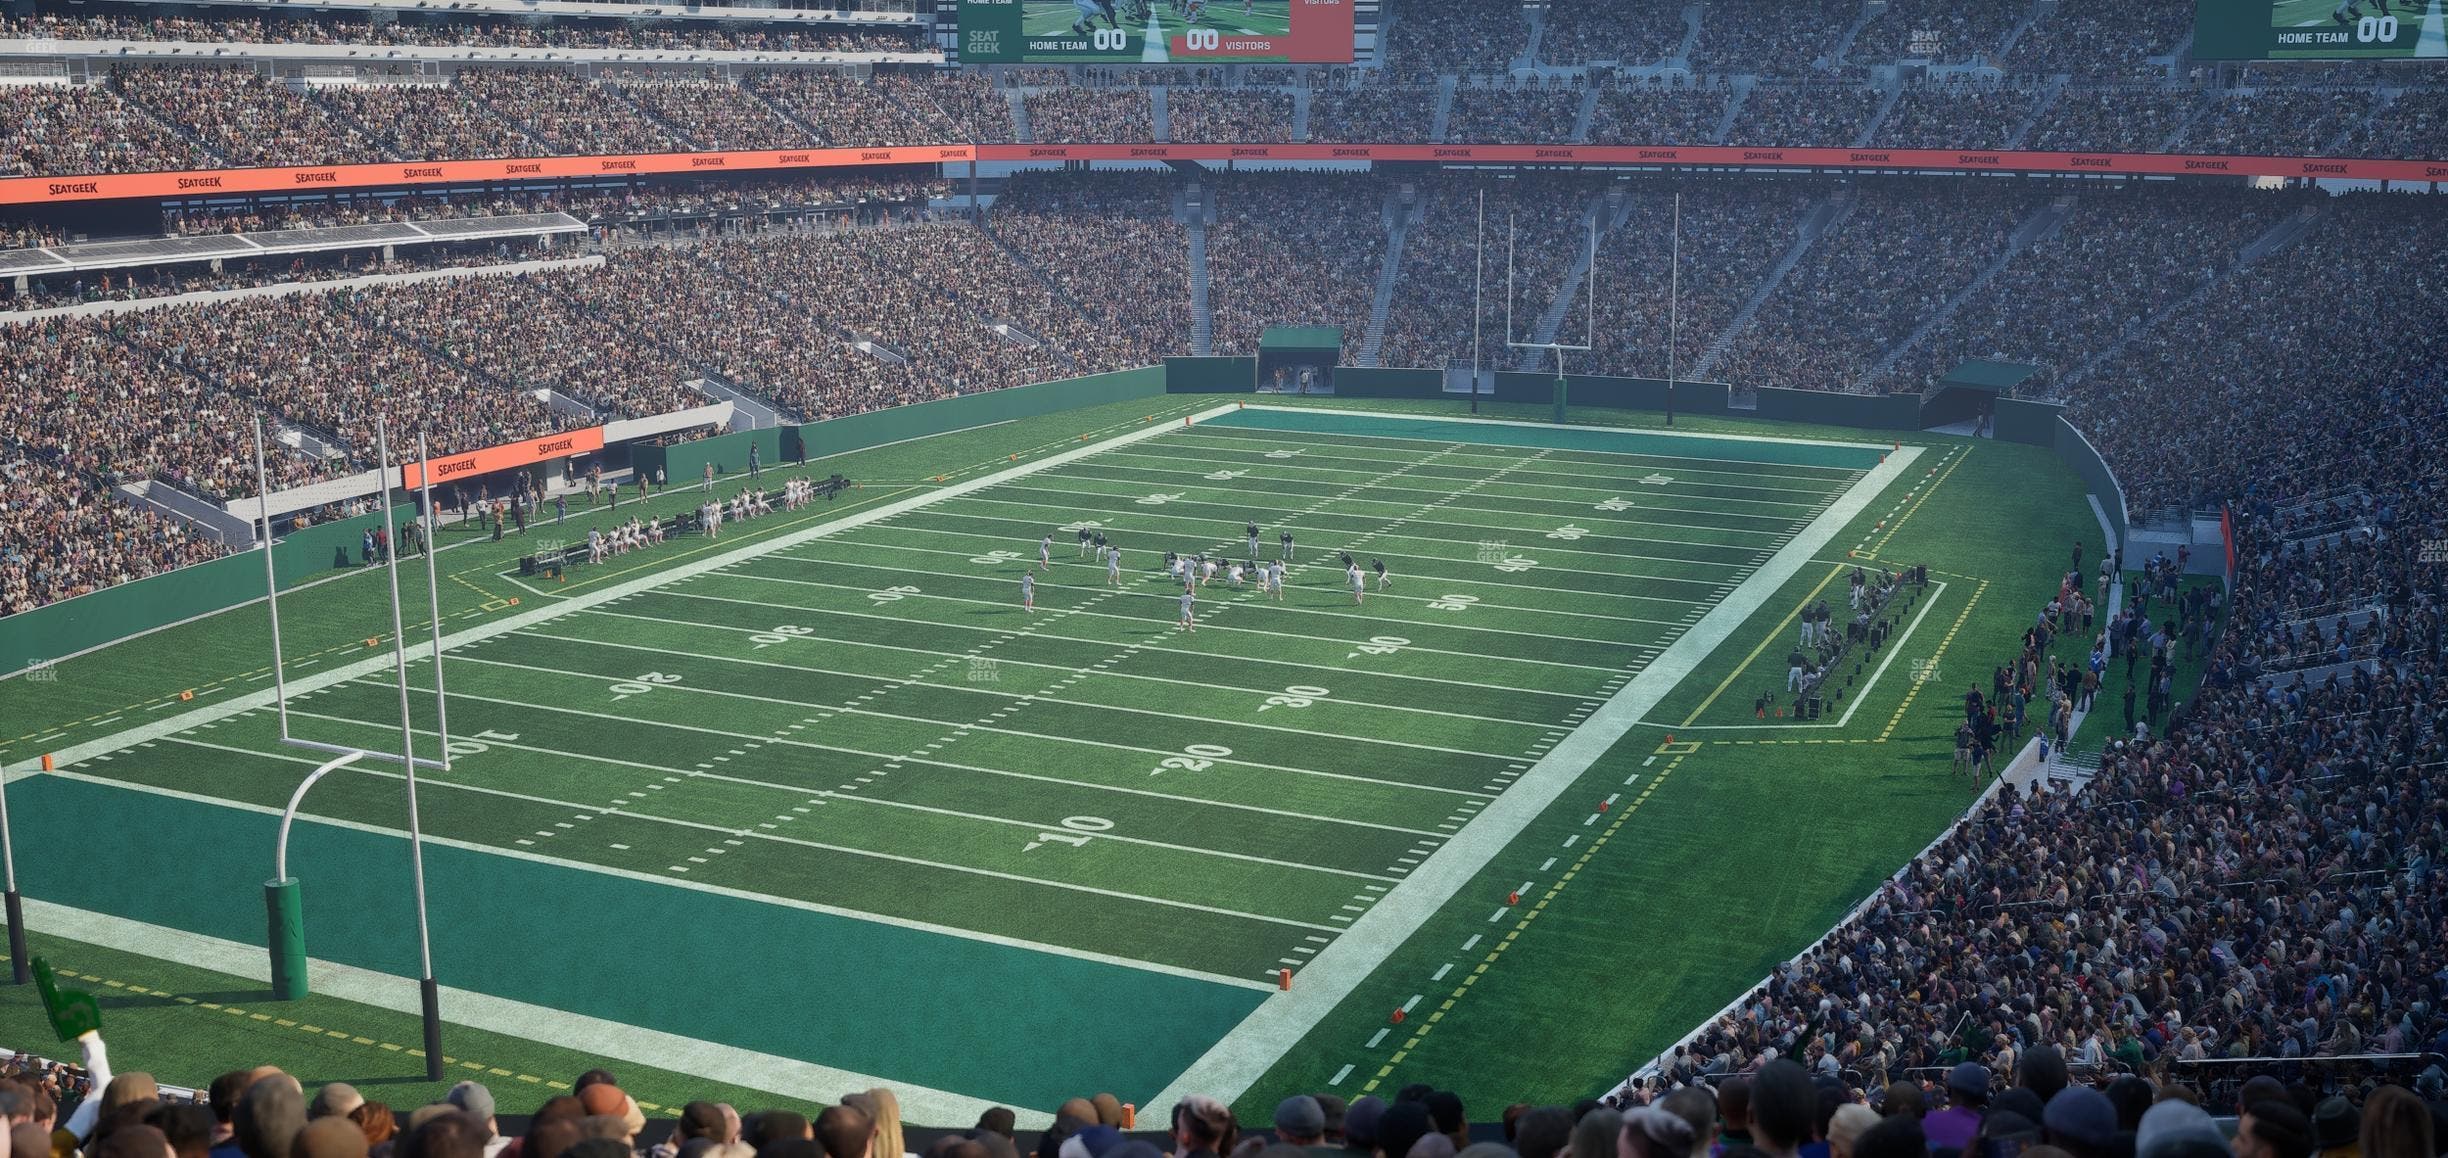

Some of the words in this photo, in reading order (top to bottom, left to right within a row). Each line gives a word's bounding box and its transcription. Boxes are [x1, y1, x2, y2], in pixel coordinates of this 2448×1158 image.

[2357, 16, 2398, 43] 00
[1094, 29, 1126, 50] 00
[1187, 29, 1219, 50] 00
[2278, 33, 2312, 43] HOME
[2316, 32, 2349, 42] TEAM
[1029, 41, 1058, 50] HOME
[1061, 41, 1088, 50] TEAM
[1226, 41, 1271, 50] VISITORS
[861, 151, 891, 161] SEATGEEK
[940, 150, 967, 159] SEATGEEK
[1030, 148, 1066, 157] SEATGEEK
[1131, 148, 1167, 157] SEATGEEK
[1232, 148, 1268, 157] SEATGEEK
[1333, 149, 1370, 157] SEATGEEK
[1434, 149, 1471, 158] SEATGEEK
[1535, 150, 1573, 158] SEATGEEK
[1639, 151, 1677, 160] SEATGEEK
[1743, 151, 1783, 160] SEATGEEK
[1850, 153, 1890, 162] SEATGEEK
[692, 157, 725, 167] SEATGEEK
[779, 154, 810, 163] SEATGEEK
[1959, 155, 1999, 164] SEATGEEK
[2071, 157, 2112, 167] SEATGEEK
[506, 164, 541, 174] SEATGEEK
[602, 160, 636, 170] SEATGEEK
[2185, 160, 2228, 171] SEATGEEK
[2303, 163, 2347, 174] SEATGEEK
[296, 171, 336, 183] SEATGEEK
[404, 168, 442, 178] SEATGEEK
[178, 176, 222, 189] SEATGEEK
[49, 182, 98, 195] SEATGEEK
[538, 439, 573, 455] SEATGEEK
[438, 458, 476, 477] SEATGEEK
[1425, 594, 1480, 611] 50
[1356, 636, 1412, 655] 40
[1265, 685, 1330, 708] 30
[1161, 744, 1233, 772] 20
[1038, 815, 1115, 847] 10
